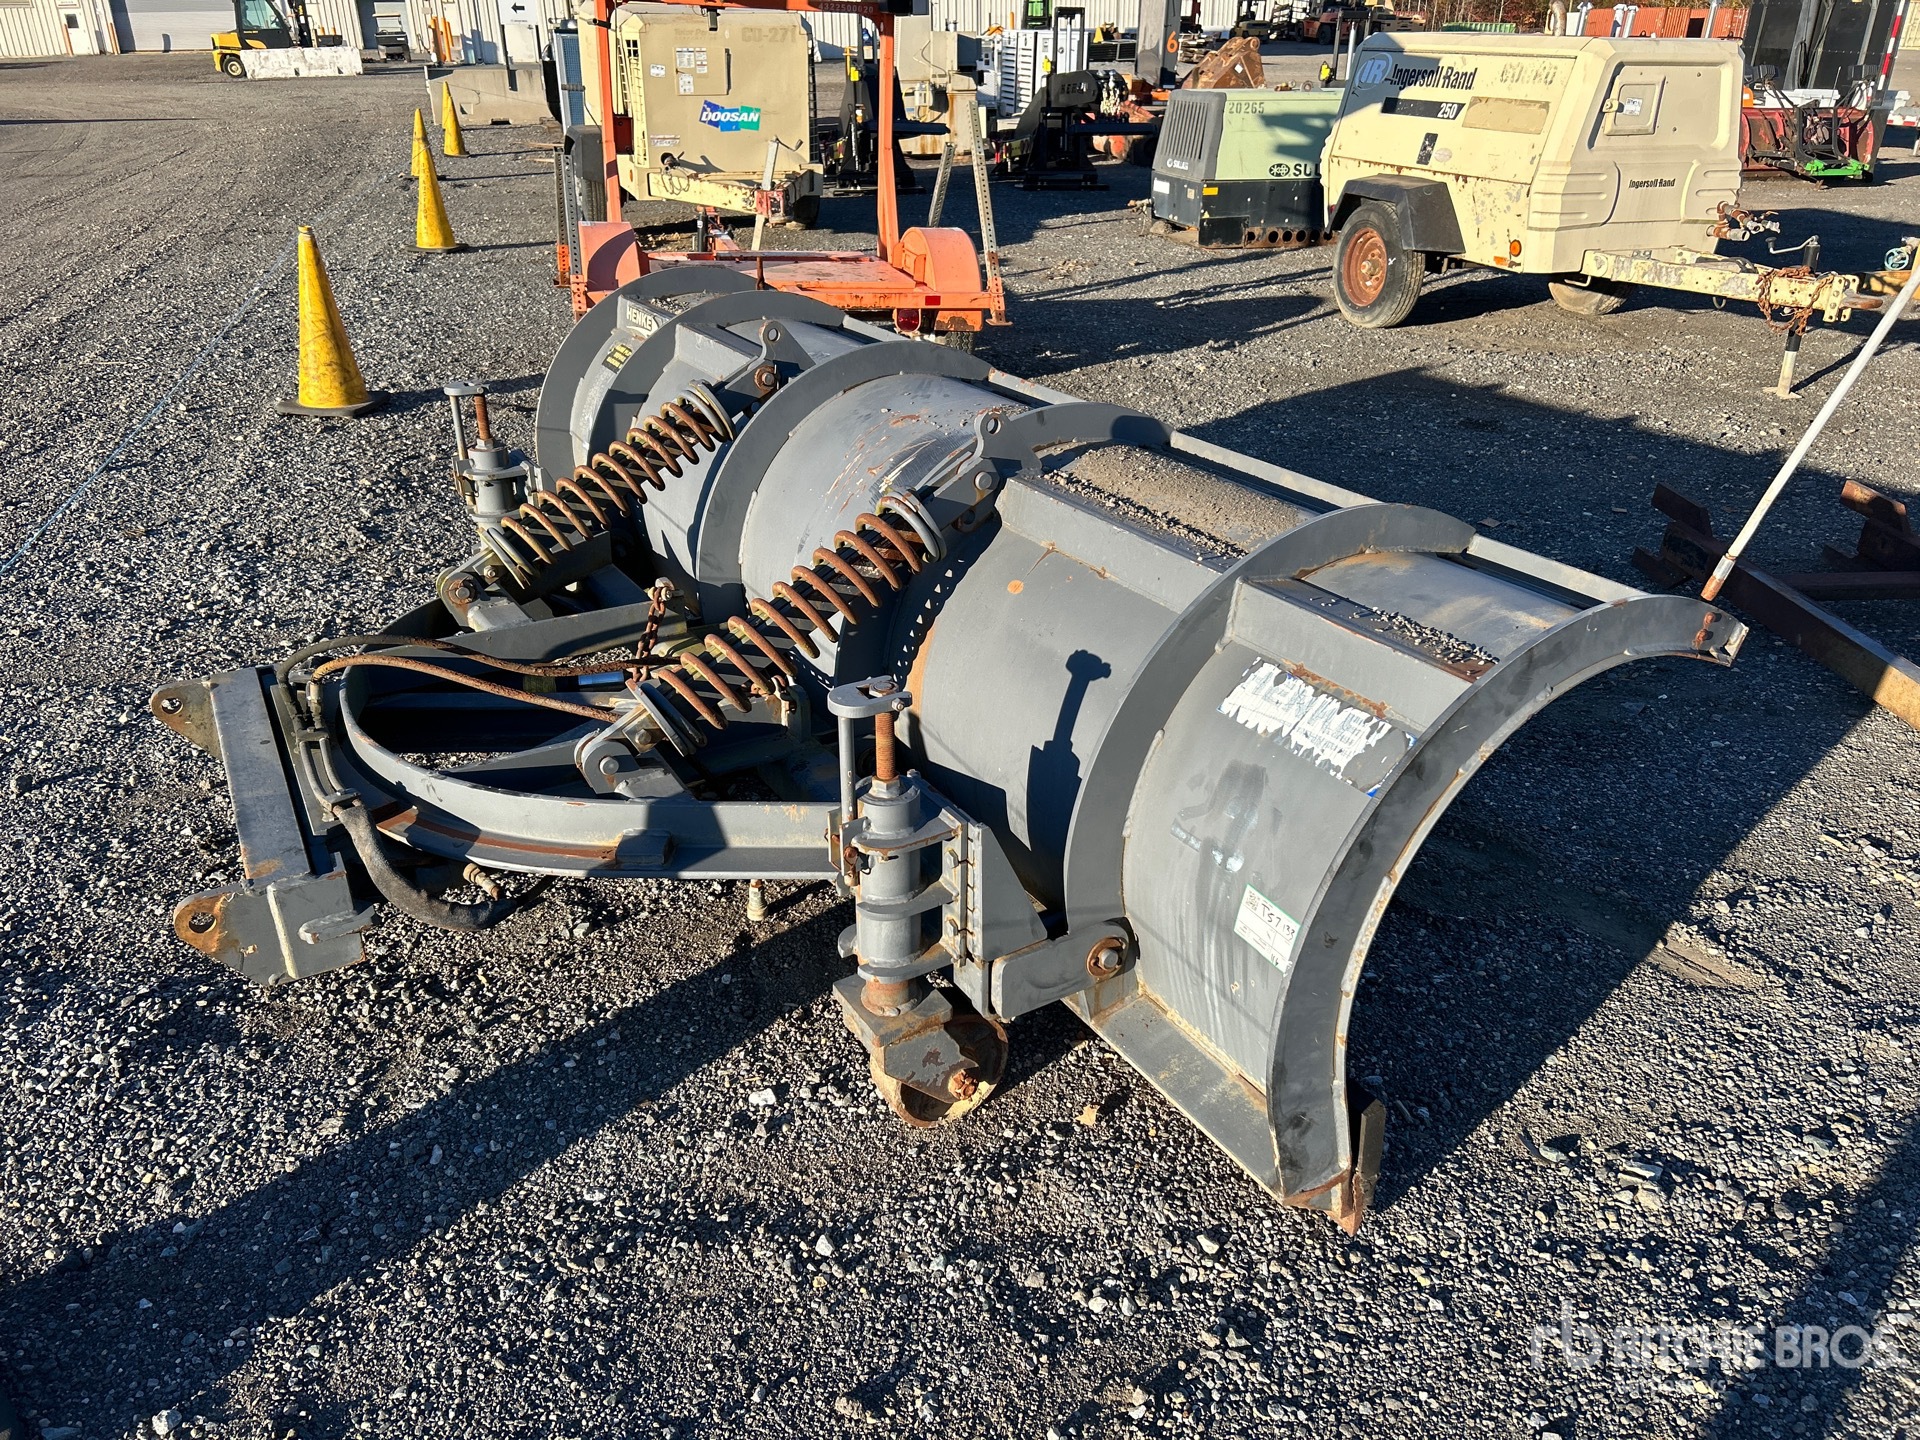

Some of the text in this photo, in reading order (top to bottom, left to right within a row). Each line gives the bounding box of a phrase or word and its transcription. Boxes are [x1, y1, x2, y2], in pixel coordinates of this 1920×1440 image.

[818, 2, 874, 14] 4322500020
[1167, 31, 1178, 53] 6
[1361, 59, 1387, 84] IR
[1388, 63, 1444, 90] Ingersoll
[1440, 66, 1478, 91] Rand
[700, 109, 759, 123] DOOSAN
[1228, 102, 1265, 114] 20265
[1437, 102, 1458, 119] 250
[1628, 179, 1659, 189] Ingersoll
[626, 303, 653, 332] HENKE
